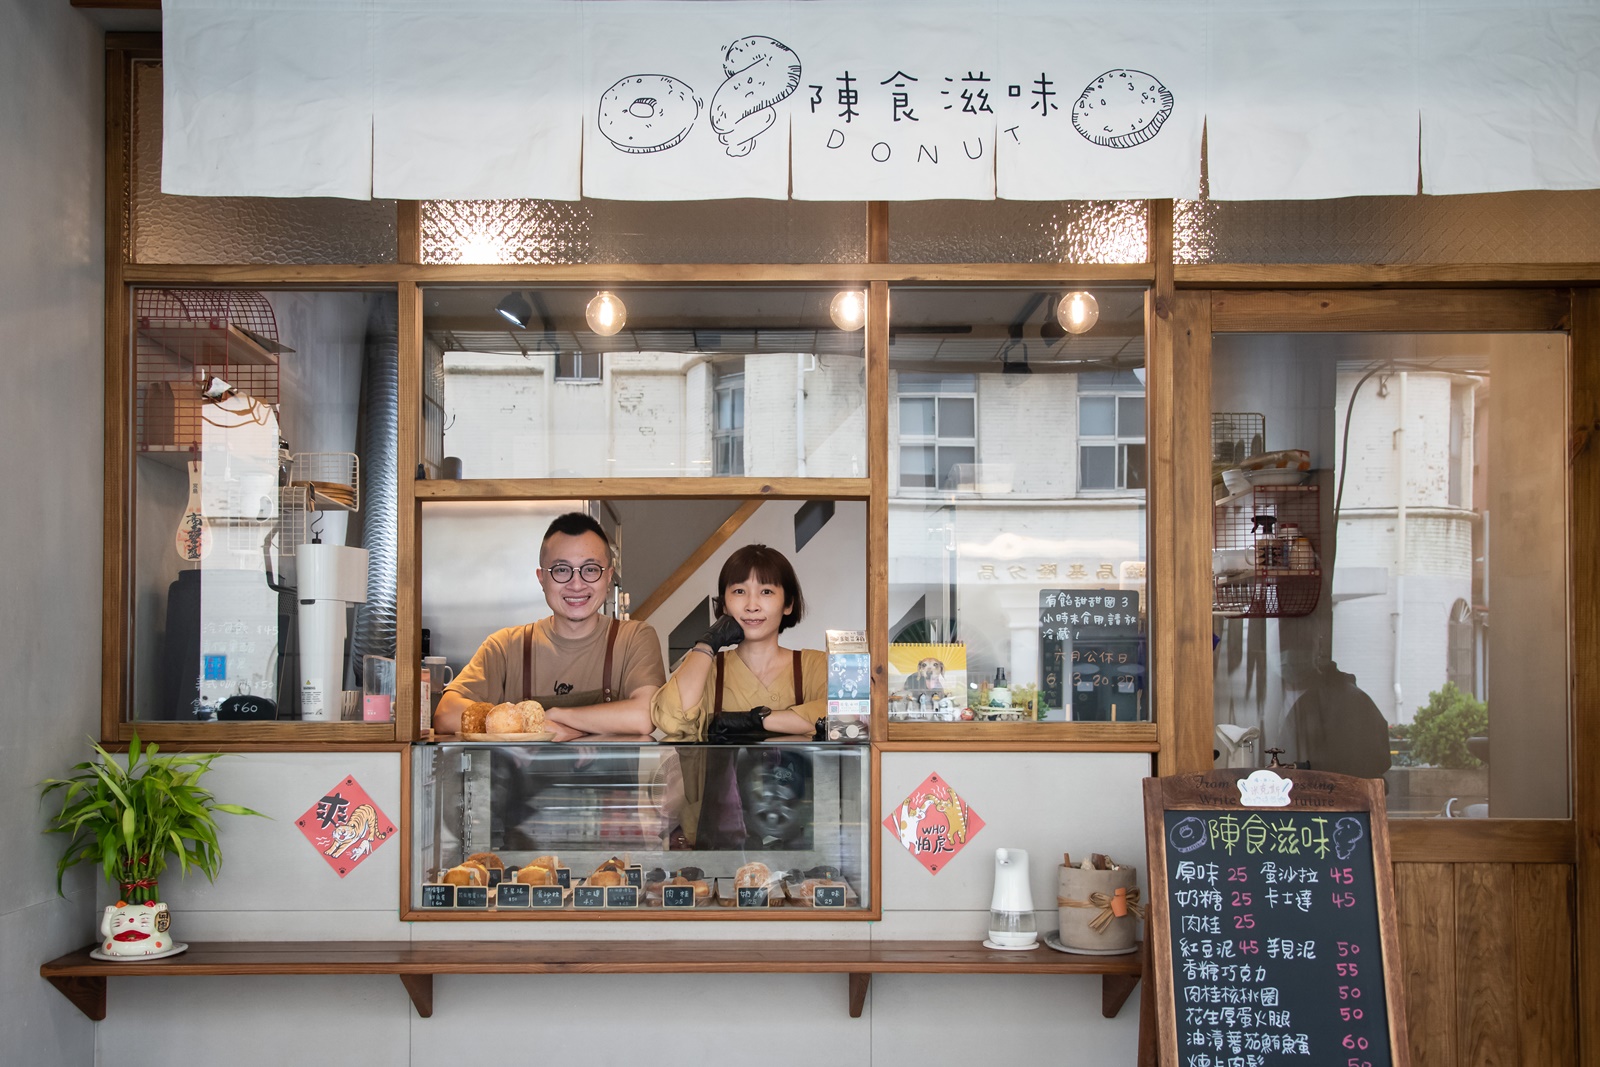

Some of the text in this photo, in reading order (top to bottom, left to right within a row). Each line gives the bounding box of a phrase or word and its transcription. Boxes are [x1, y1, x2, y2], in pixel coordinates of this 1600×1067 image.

[809, 71, 1060, 123] 陳食滋味
[826, 126, 1021, 164] DONUT
[1045, 592, 1129, 608] 有餡甜甜圈 3
[1054, 649, 1128, 663] 六月公休日
[233, 702, 258, 713] $60
[1199, 794, 1236, 805] Write
[1294, 794, 1335, 806] future
[316, 793, 350, 829] 爽
[921, 825, 946, 836] WHO
[1208, 814, 1331, 860] 陳食滋味
[1175, 861, 1354, 886] 原味 25 蛋沙拉 45
[1175, 887, 1356, 912] 奶糖 25 卡士達 45
[1181, 914, 1255, 934] 肉桂 25
[1179, 938, 1236, 959] 紅豆泥
[1239, 940, 1259, 955] 45
[1336, 941, 1360, 957] 50
[1336, 963, 1359, 977] 55
[1184, 985, 1362, 1007] 肉桂核桃圈 50
[1185, 1007, 1364, 1028] 花生厚蛋火腿 50
[1342, 1034, 1369, 1051] 60
